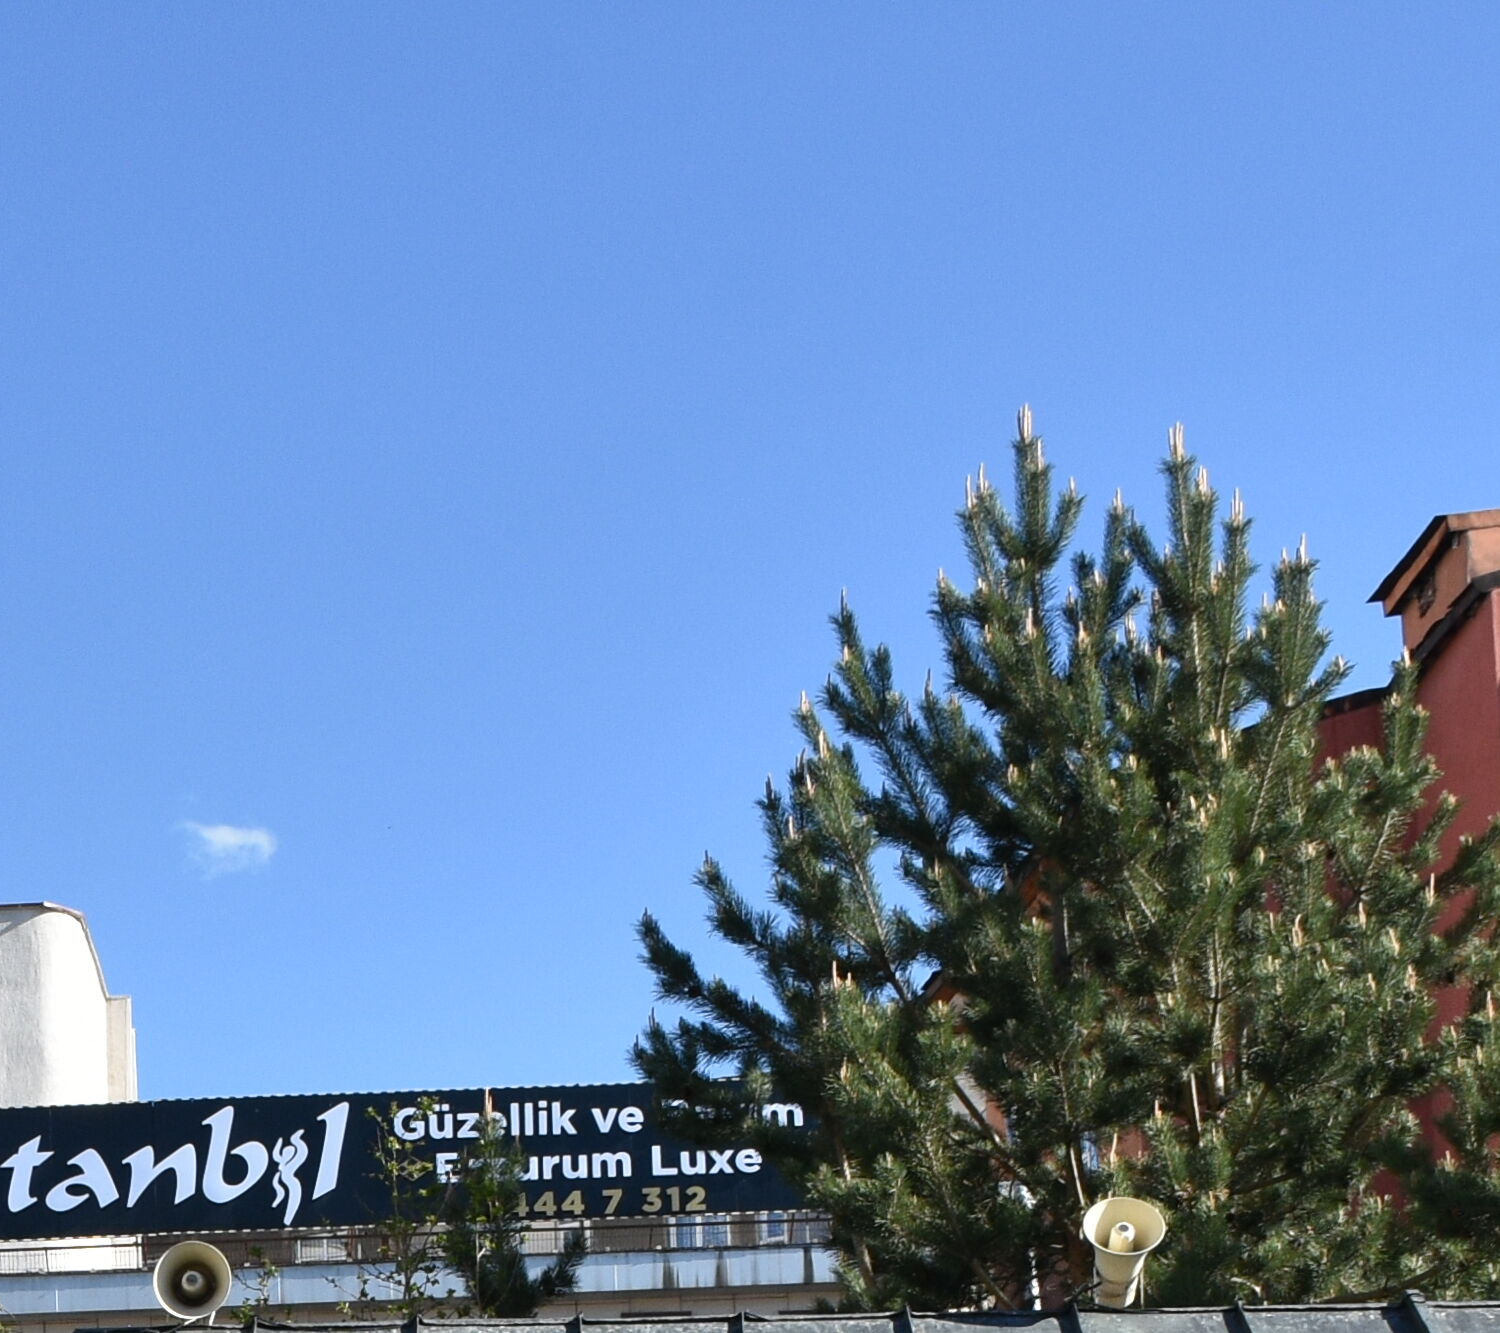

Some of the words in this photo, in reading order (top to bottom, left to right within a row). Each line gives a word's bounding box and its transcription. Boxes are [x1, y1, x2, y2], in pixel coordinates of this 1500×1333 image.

[393, 1100, 577, 1141] Güzellik
[594, 1104, 644, 1133] ve
[435, 1151, 632, 1184] Eurum
[651, 1145, 763, 1178] Luxe
[602, 1188, 625, 1215] 7
[641, 1186, 707, 1213] 312
